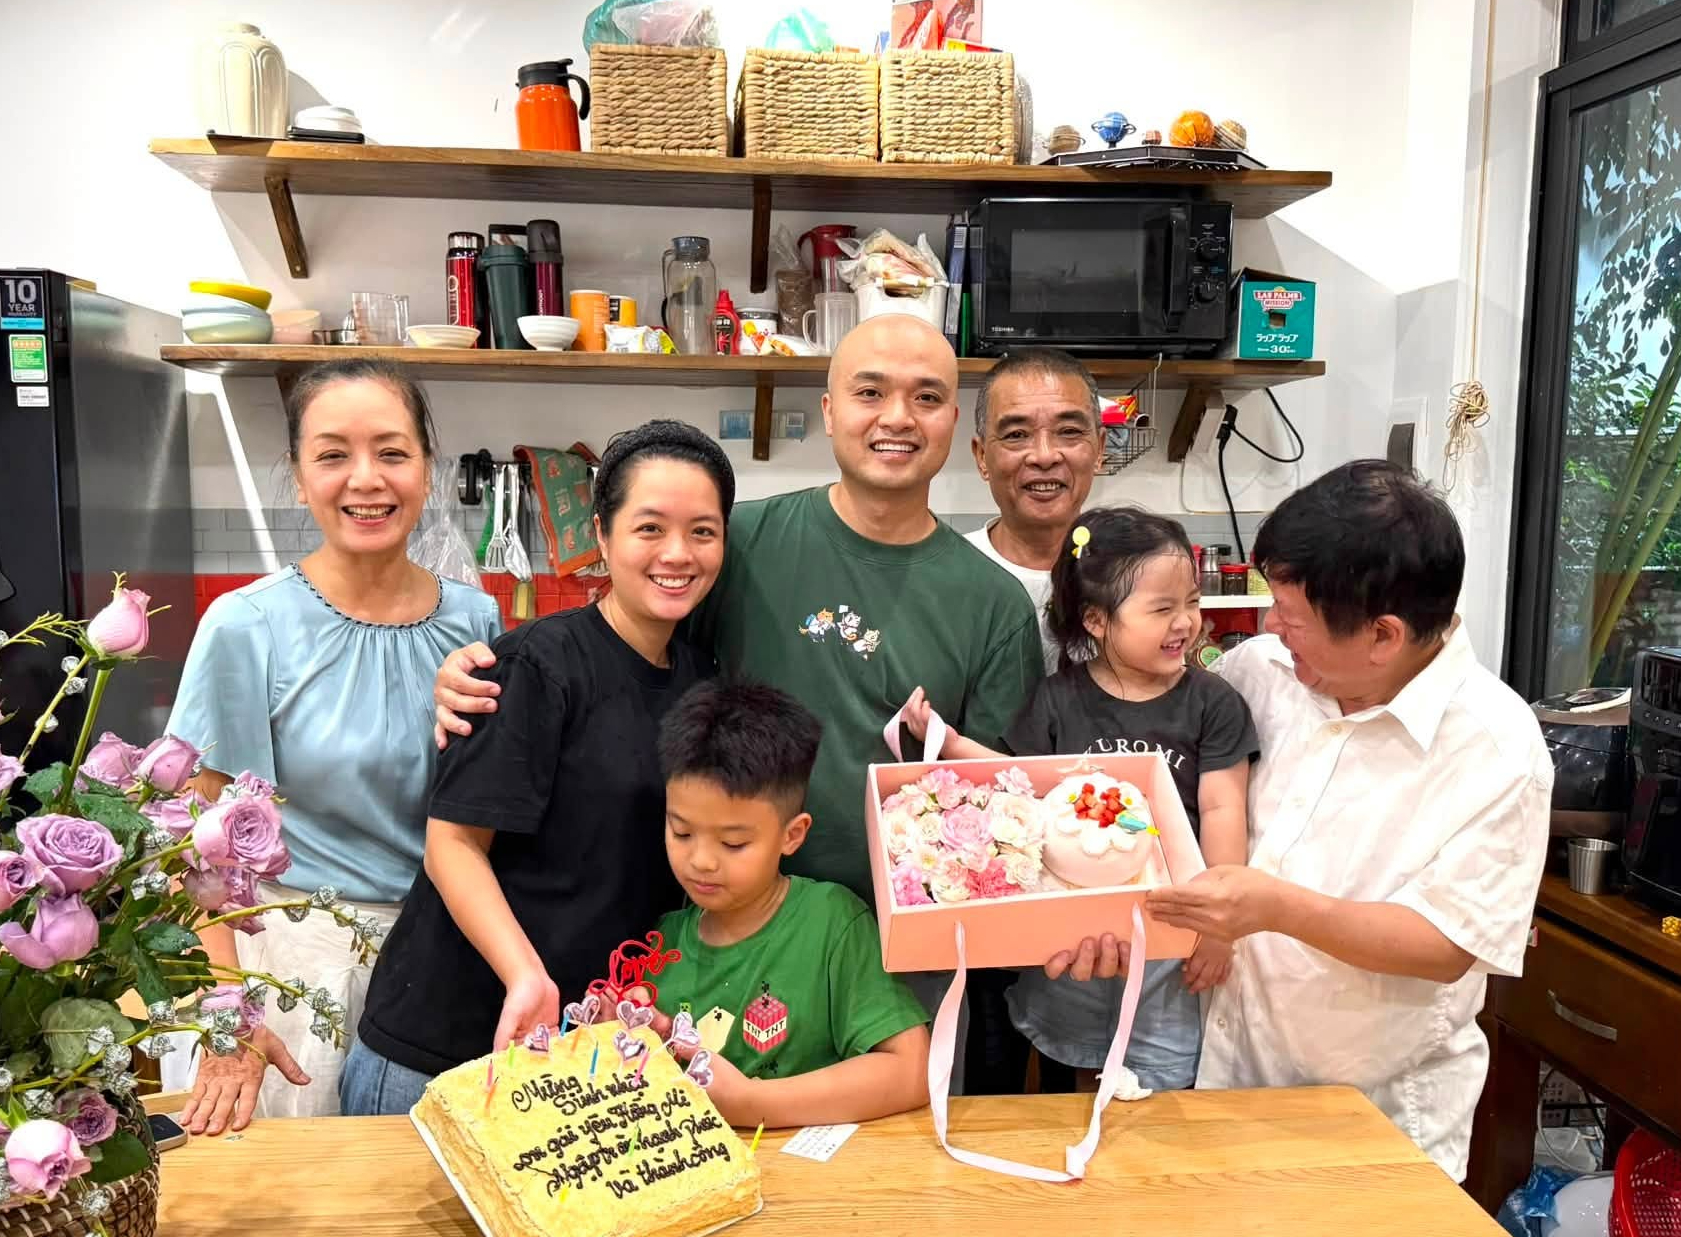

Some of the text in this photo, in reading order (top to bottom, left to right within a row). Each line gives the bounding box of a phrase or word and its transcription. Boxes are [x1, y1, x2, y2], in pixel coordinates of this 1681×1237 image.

[5, 279, 37, 304] 10
[8, 303, 35, 312] YEAR
[1084, 738, 1186, 770] UROMI
[745, 1021, 761, 1038] TNT
[766, 1020, 784, 1038] TNT
